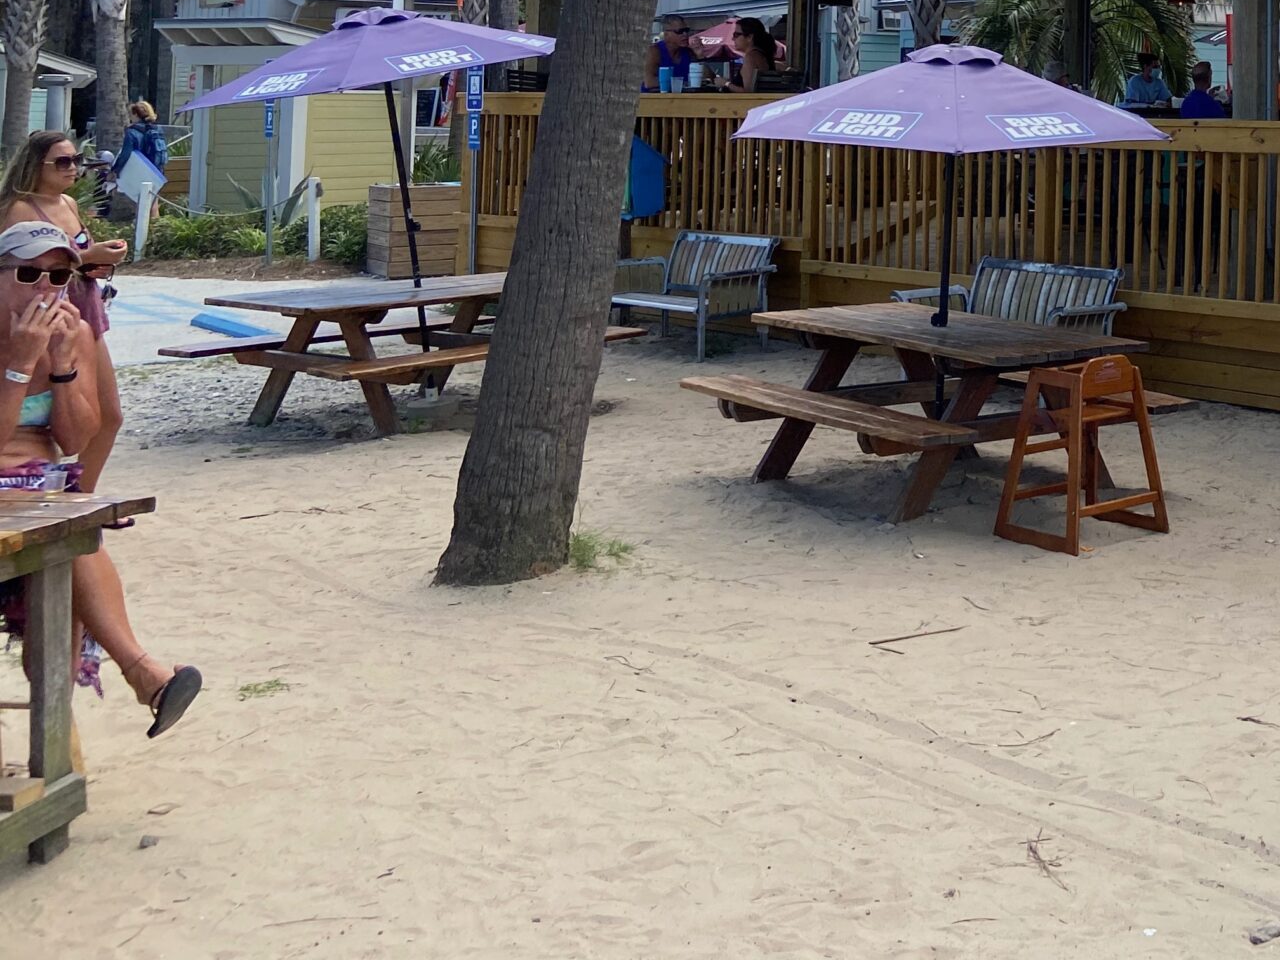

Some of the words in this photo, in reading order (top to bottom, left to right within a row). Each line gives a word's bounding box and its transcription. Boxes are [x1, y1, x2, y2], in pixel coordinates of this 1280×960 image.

[398, 53, 473, 71] LIGHT
[401, 50, 457, 64] BUD
[262, 73, 308, 86] BUD
[240, 80, 306, 96] LIGHT
[471, 119, 478, 135] P
[840, 112, 902, 126] BUD
[1003, 116, 1063, 127] BUD
[817, 121, 904, 138] LIGHT
[1005, 122, 1085, 138] LIGHT
